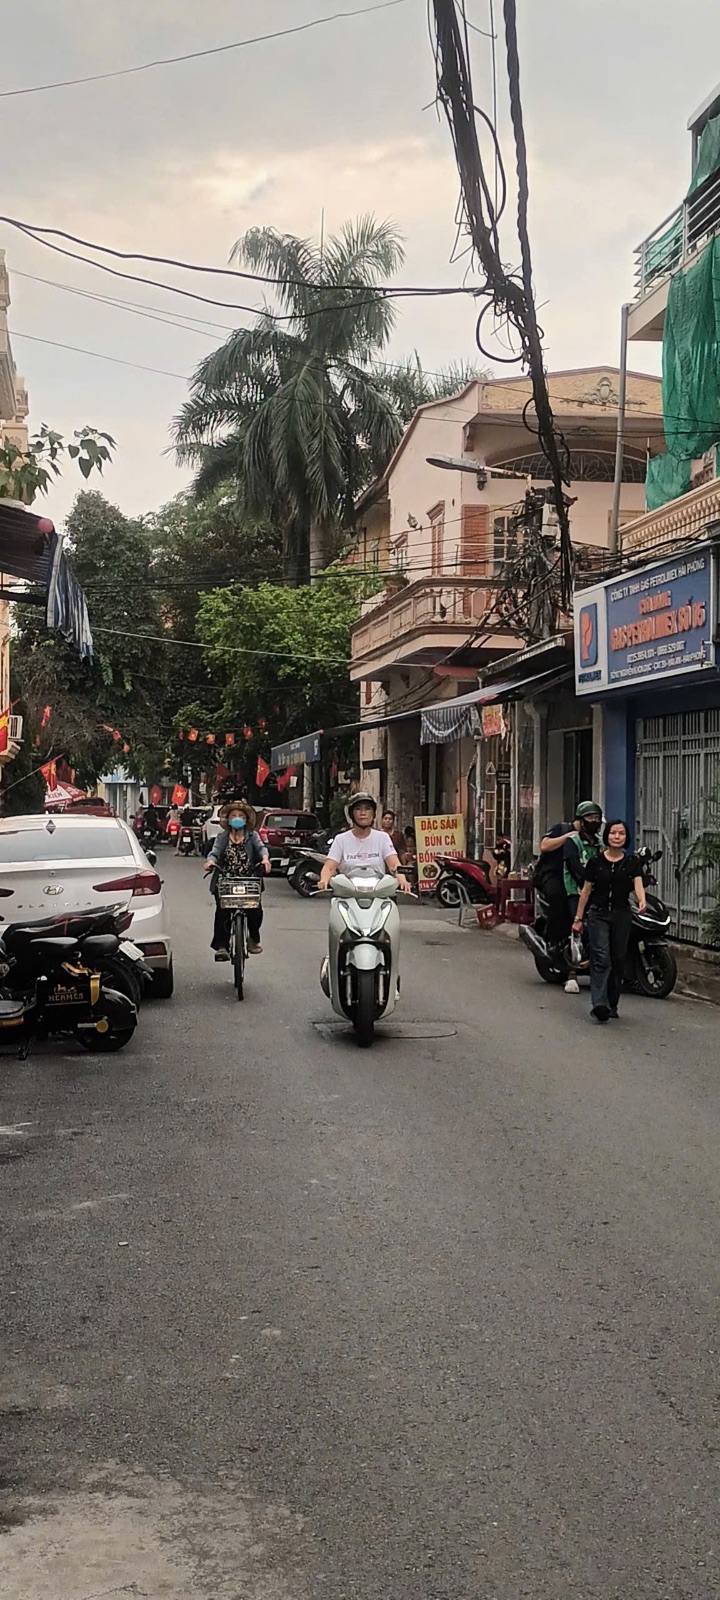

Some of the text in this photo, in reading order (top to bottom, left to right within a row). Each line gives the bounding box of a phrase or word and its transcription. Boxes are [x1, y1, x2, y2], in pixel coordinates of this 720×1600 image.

[420, 815, 458, 833] ĐẶC SẢN
[424, 832, 456, 847] BÚN CÁ
[418, 848, 442, 863] BỐN
